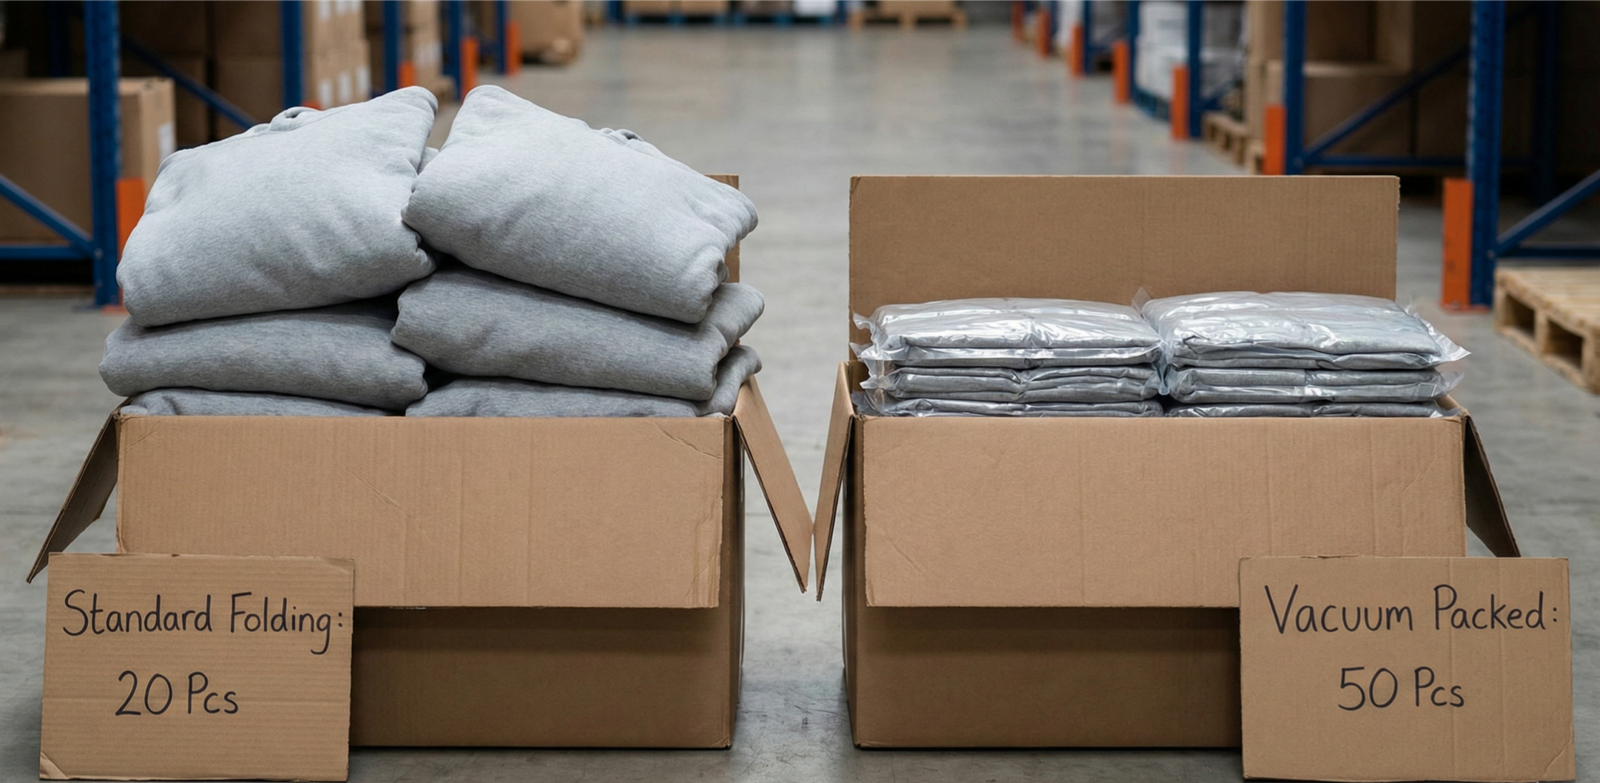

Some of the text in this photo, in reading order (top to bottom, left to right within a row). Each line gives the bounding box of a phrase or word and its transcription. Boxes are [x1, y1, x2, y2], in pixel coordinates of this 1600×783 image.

[62, 588, 344, 656] Standard Folding:
[1264, 583, 1558, 635] Vacuum Packed:
[114, 670, 239, 717] 20 Pcs
[1338, 666, 1465, 712] 50 Pcs
